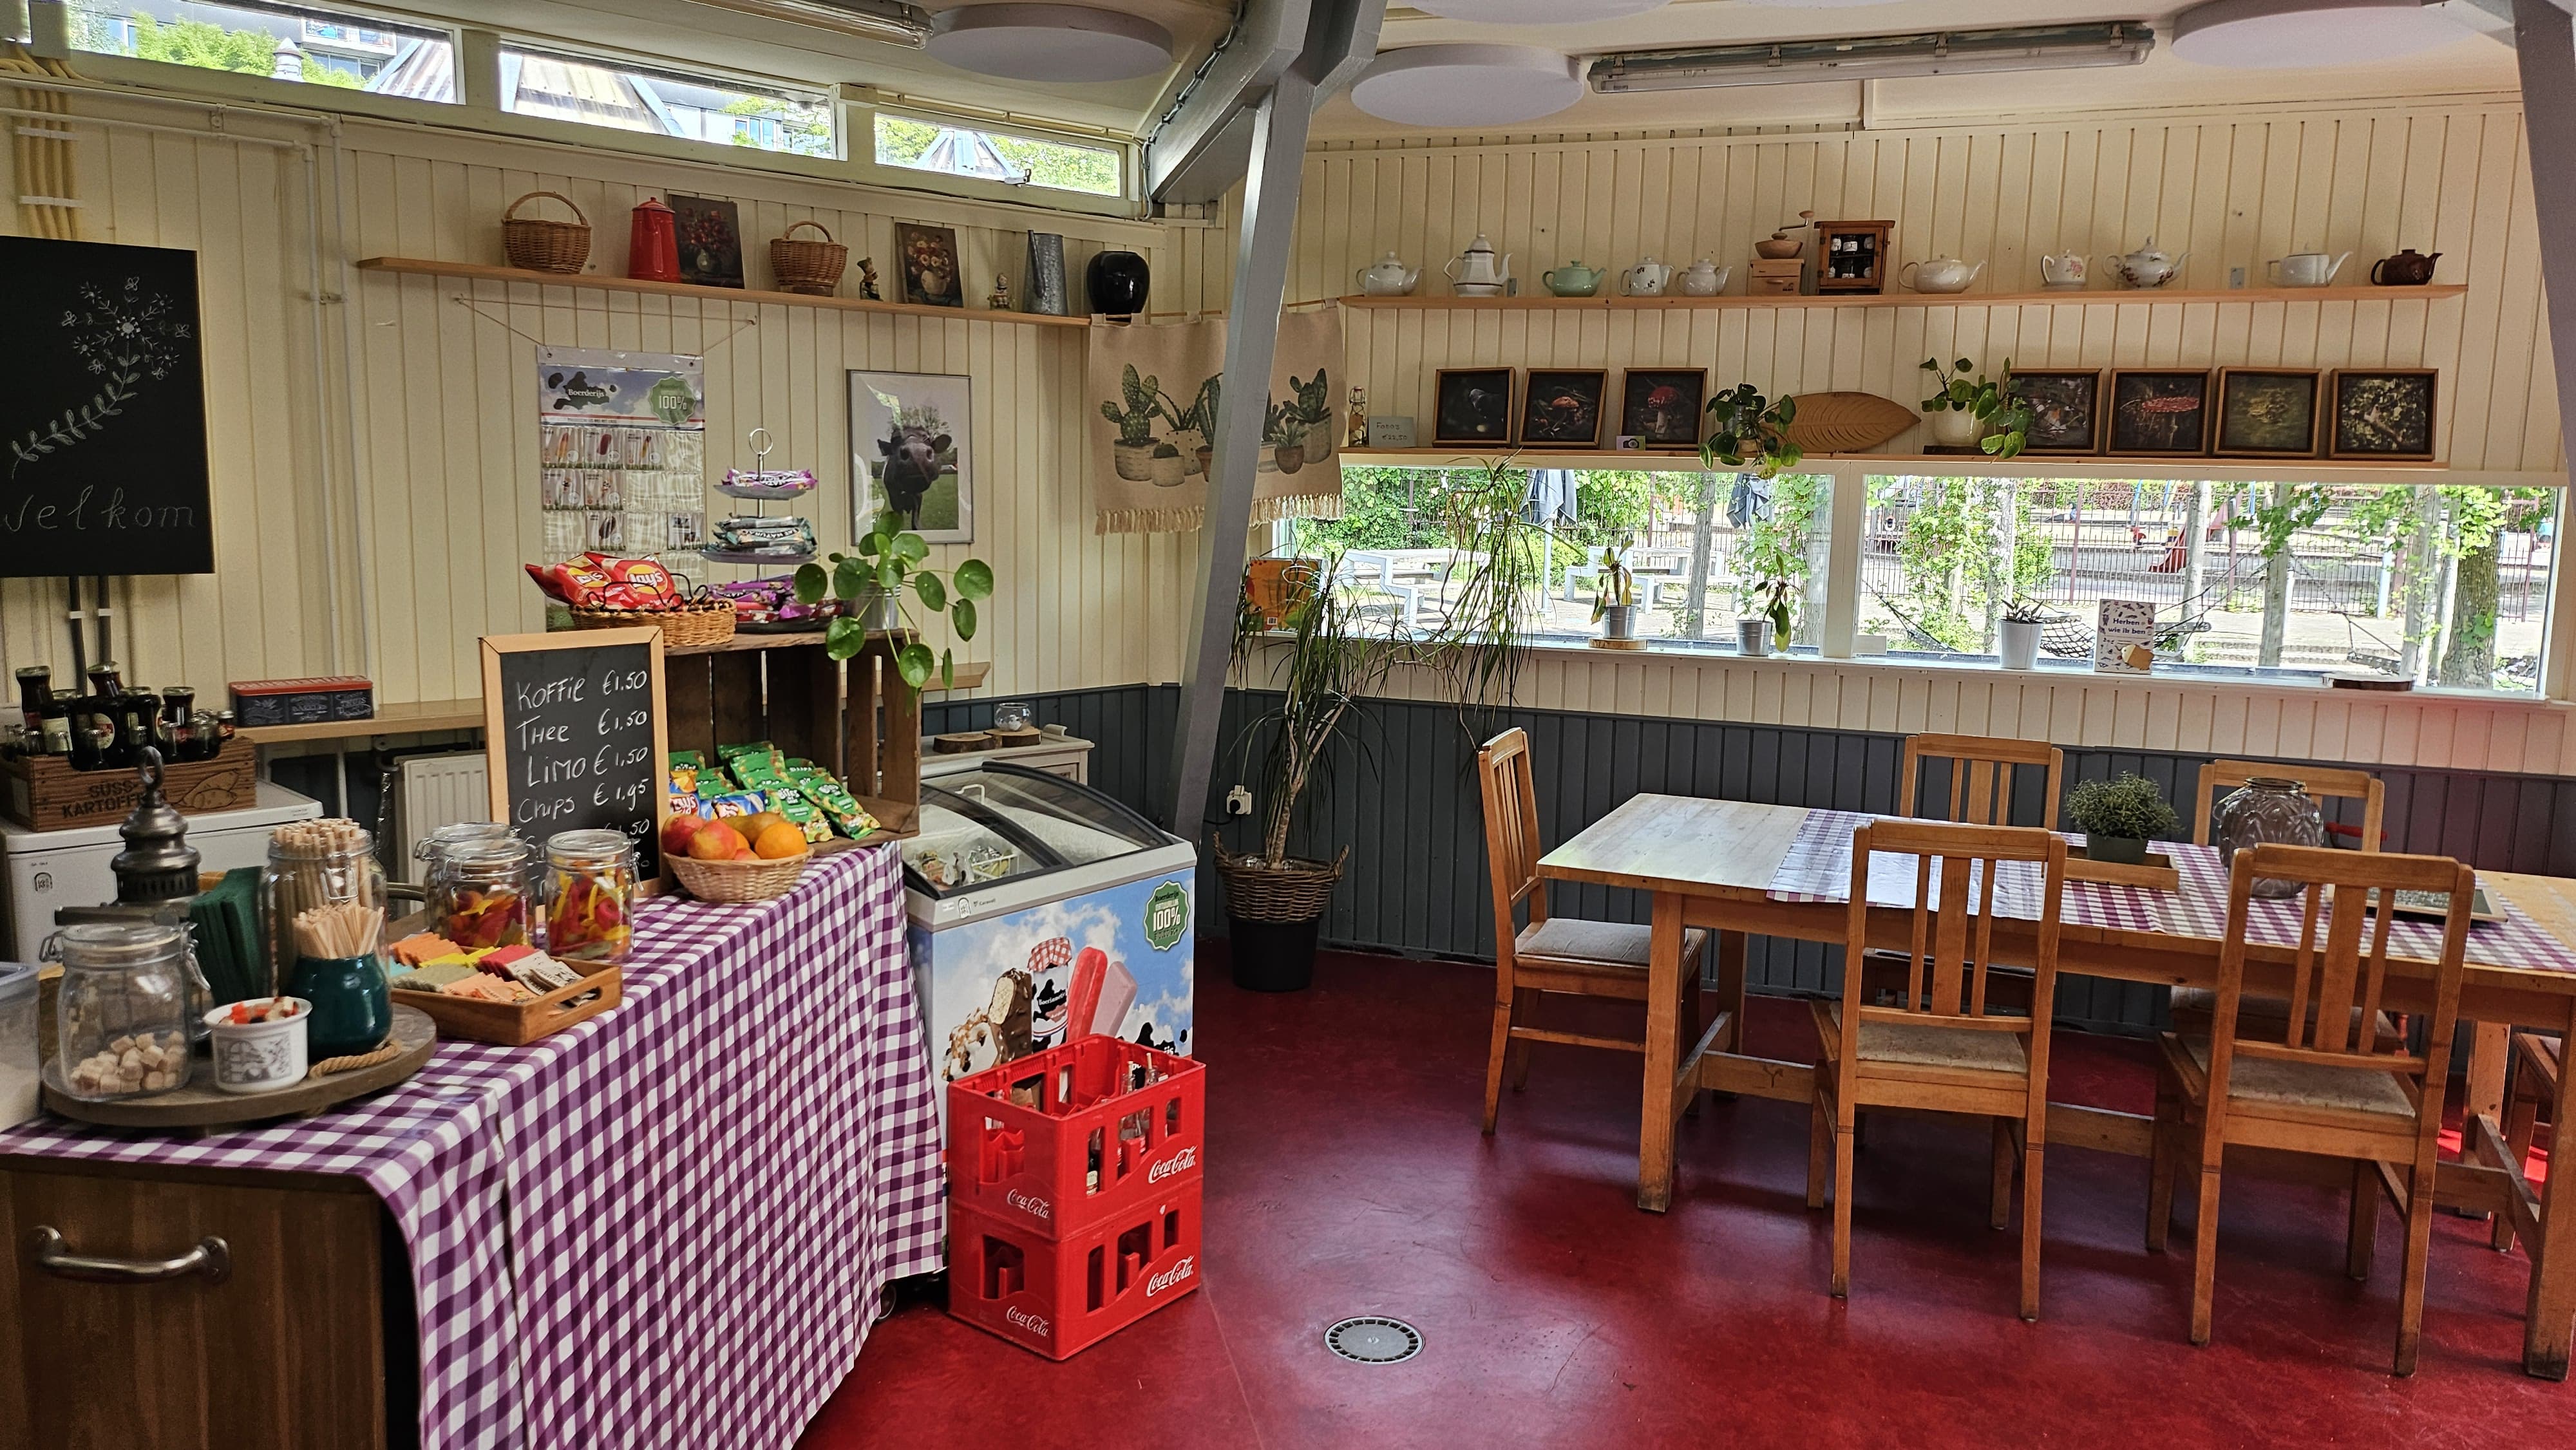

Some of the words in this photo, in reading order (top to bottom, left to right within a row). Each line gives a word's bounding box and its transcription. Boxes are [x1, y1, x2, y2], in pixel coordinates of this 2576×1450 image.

[568, 388, 605, 398] Boerderijs
[659, 395, 687, 410] 100%
[1153, 906, 1181, 932] 100%
[1148, 1145, 1198, 1183] Coca-Cola
[1007, 1189, 1050, 1219] Coca-Cola
[1146, 1255, 1195, 1297] Coca-Cola
[1007, 1305, 1050, 1337] Coca-Cola
